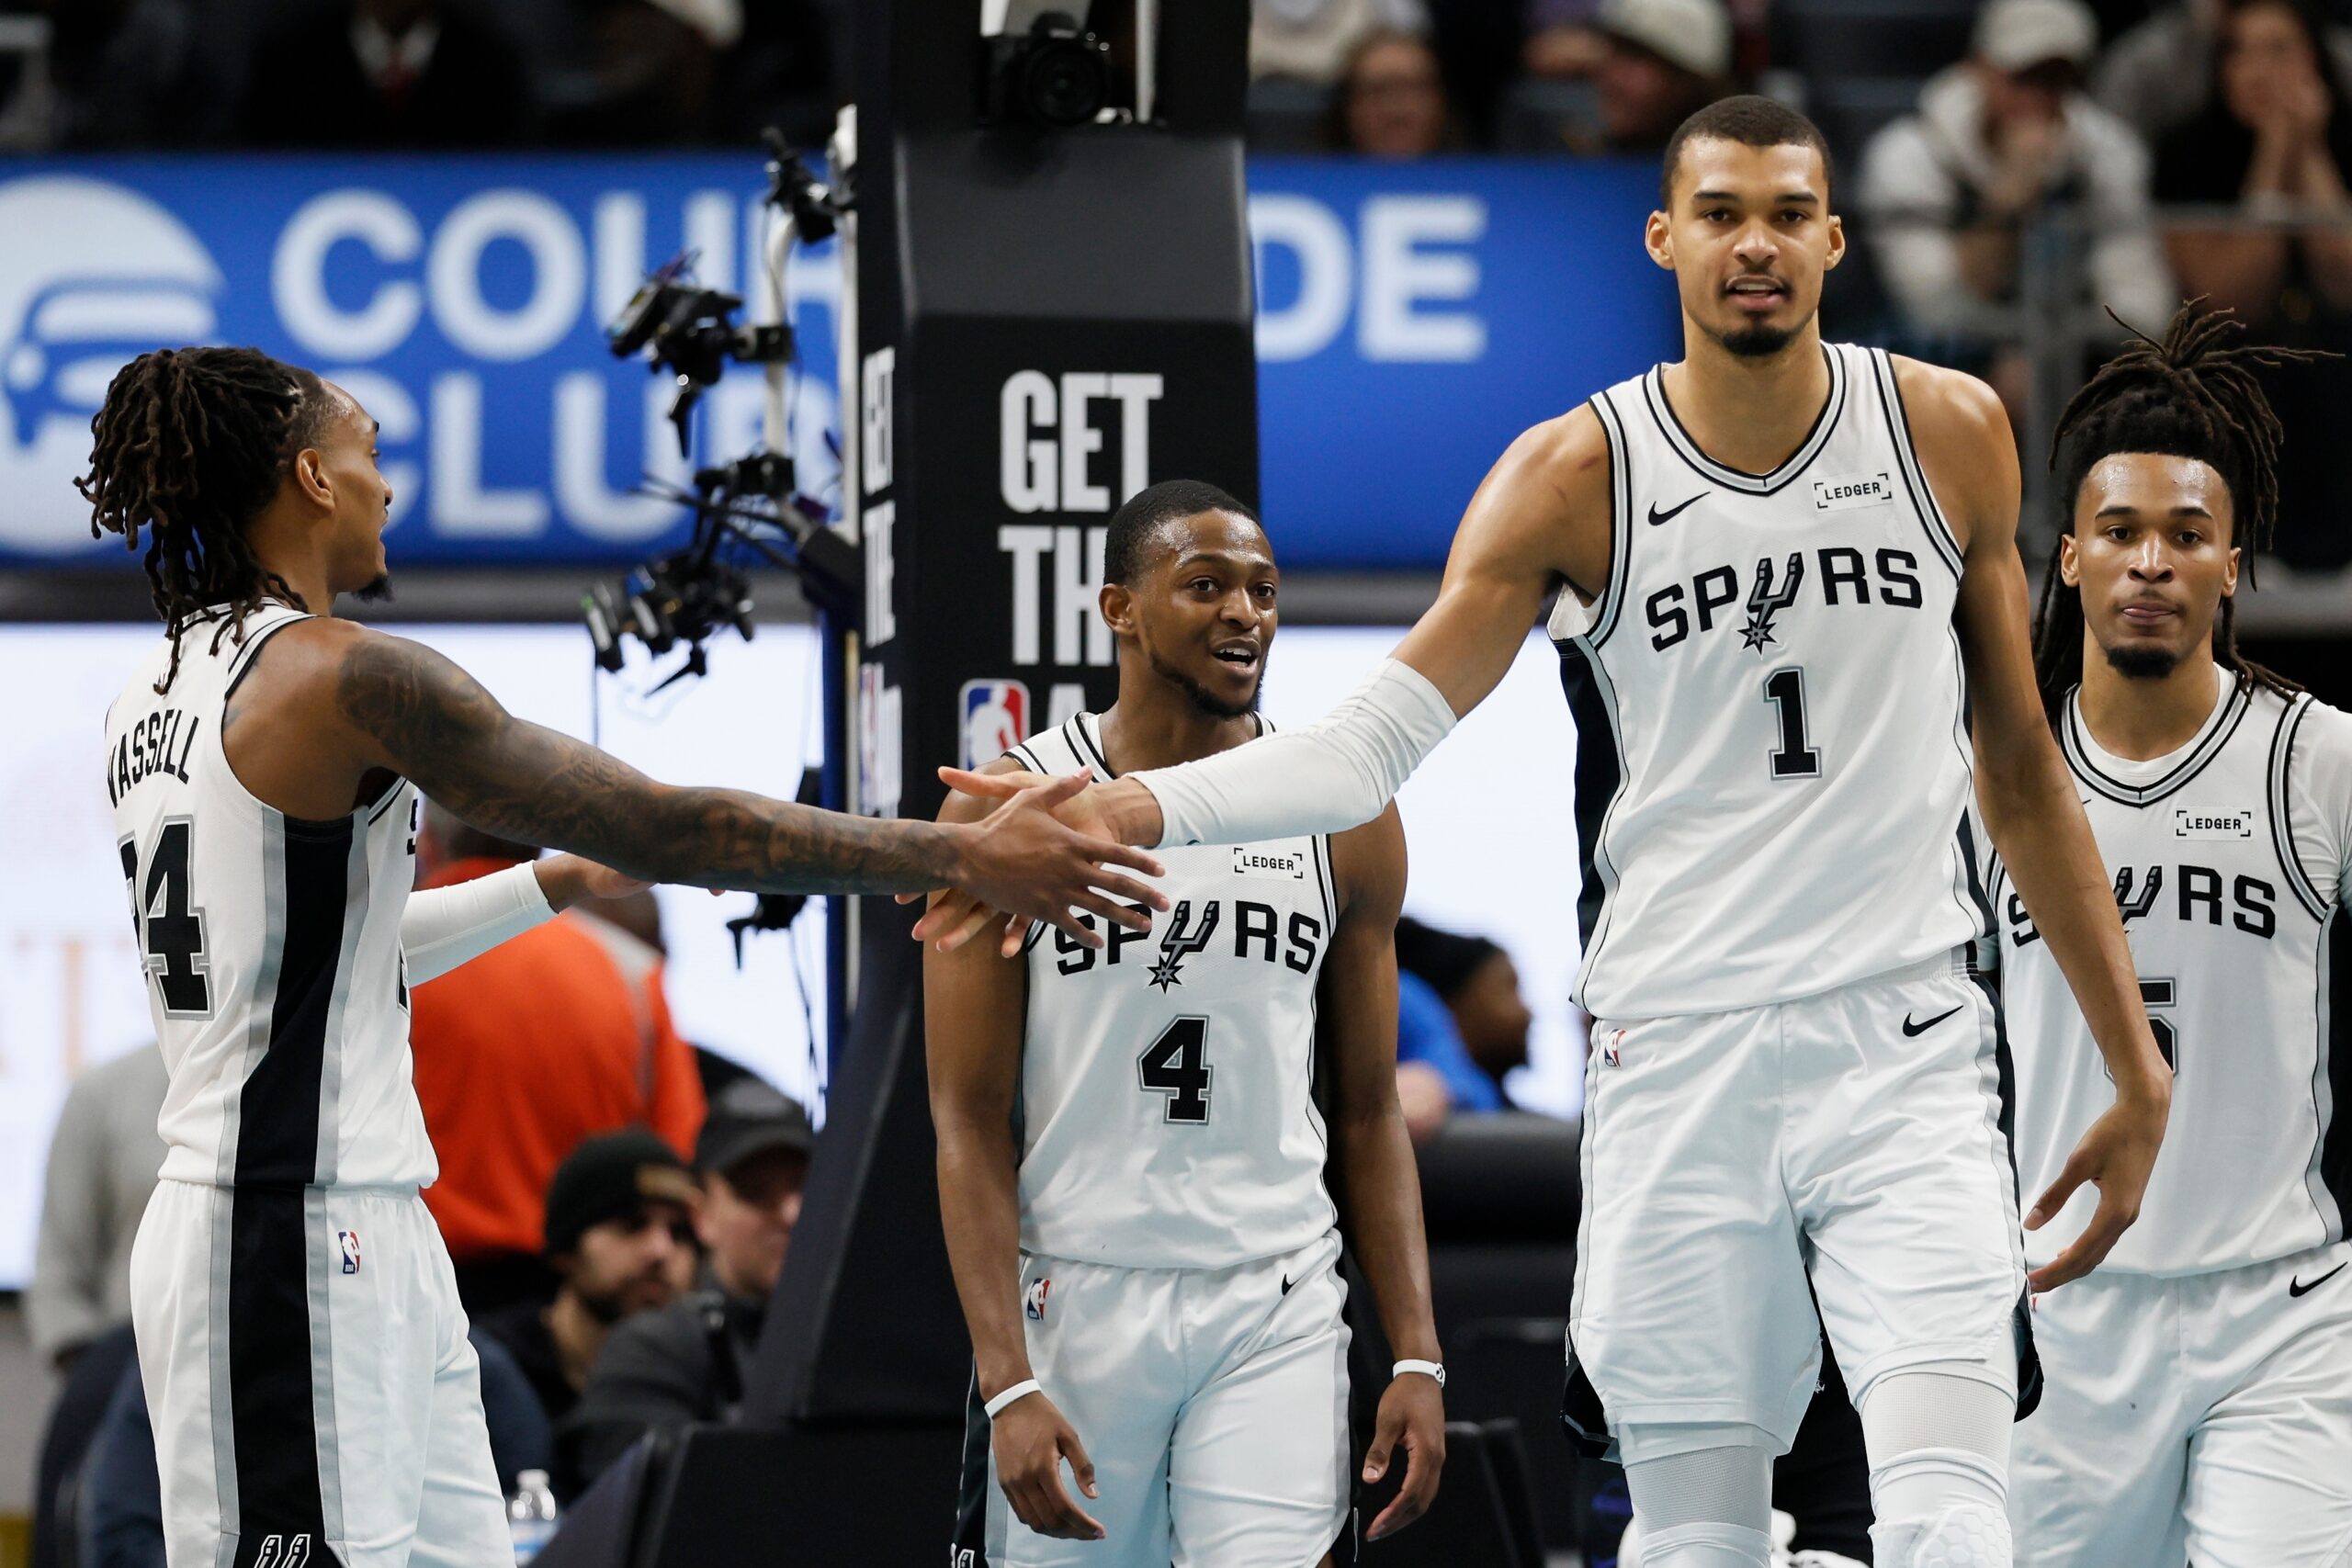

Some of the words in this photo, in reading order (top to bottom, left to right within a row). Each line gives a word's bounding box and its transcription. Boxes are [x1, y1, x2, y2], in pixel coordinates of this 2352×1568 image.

[1000, 369, 1164, 513] GET
[1824, 481, 1882, 501] LEDGER
[999, 525, 1121, 667] TH
[1645, 547, 1922, 655] SPURS
[107, 708, 199, 809] VASSELL
[1763, 666, 1822, 781] 1
[1242, 854, 1295, 872] LEDGER
[2185, 818, 2243, 830] LEDGER
[1055, 900, 1320, 985] SPURS
[2007, 864, 2276, 947] SURS
[1136, 1014, 1214, 1126] 4
